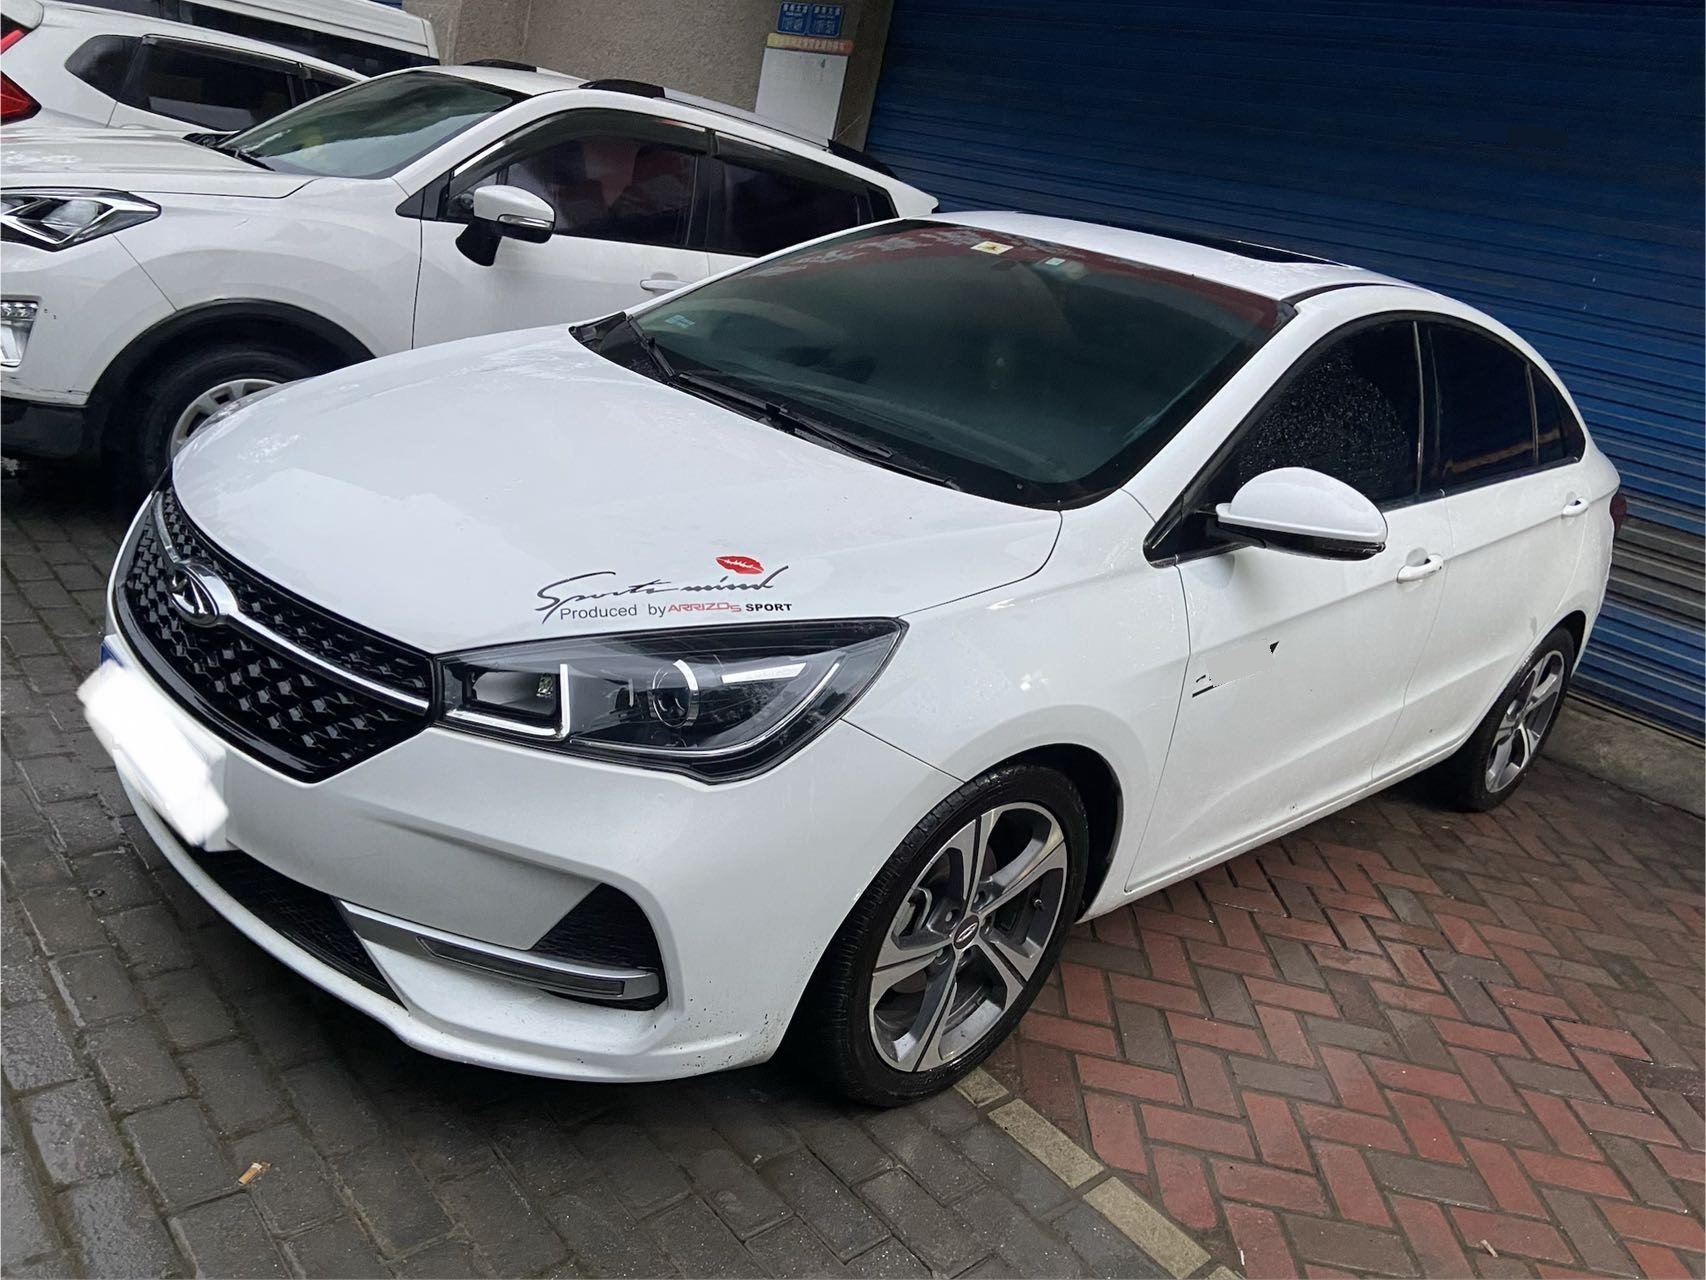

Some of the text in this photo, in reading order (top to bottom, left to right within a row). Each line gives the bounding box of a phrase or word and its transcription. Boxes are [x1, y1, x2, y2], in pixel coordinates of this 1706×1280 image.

[560, 604, 638, 620] Produced
[649, 603, 667, 618] by
[745, 603, 792, 612] SPORT
